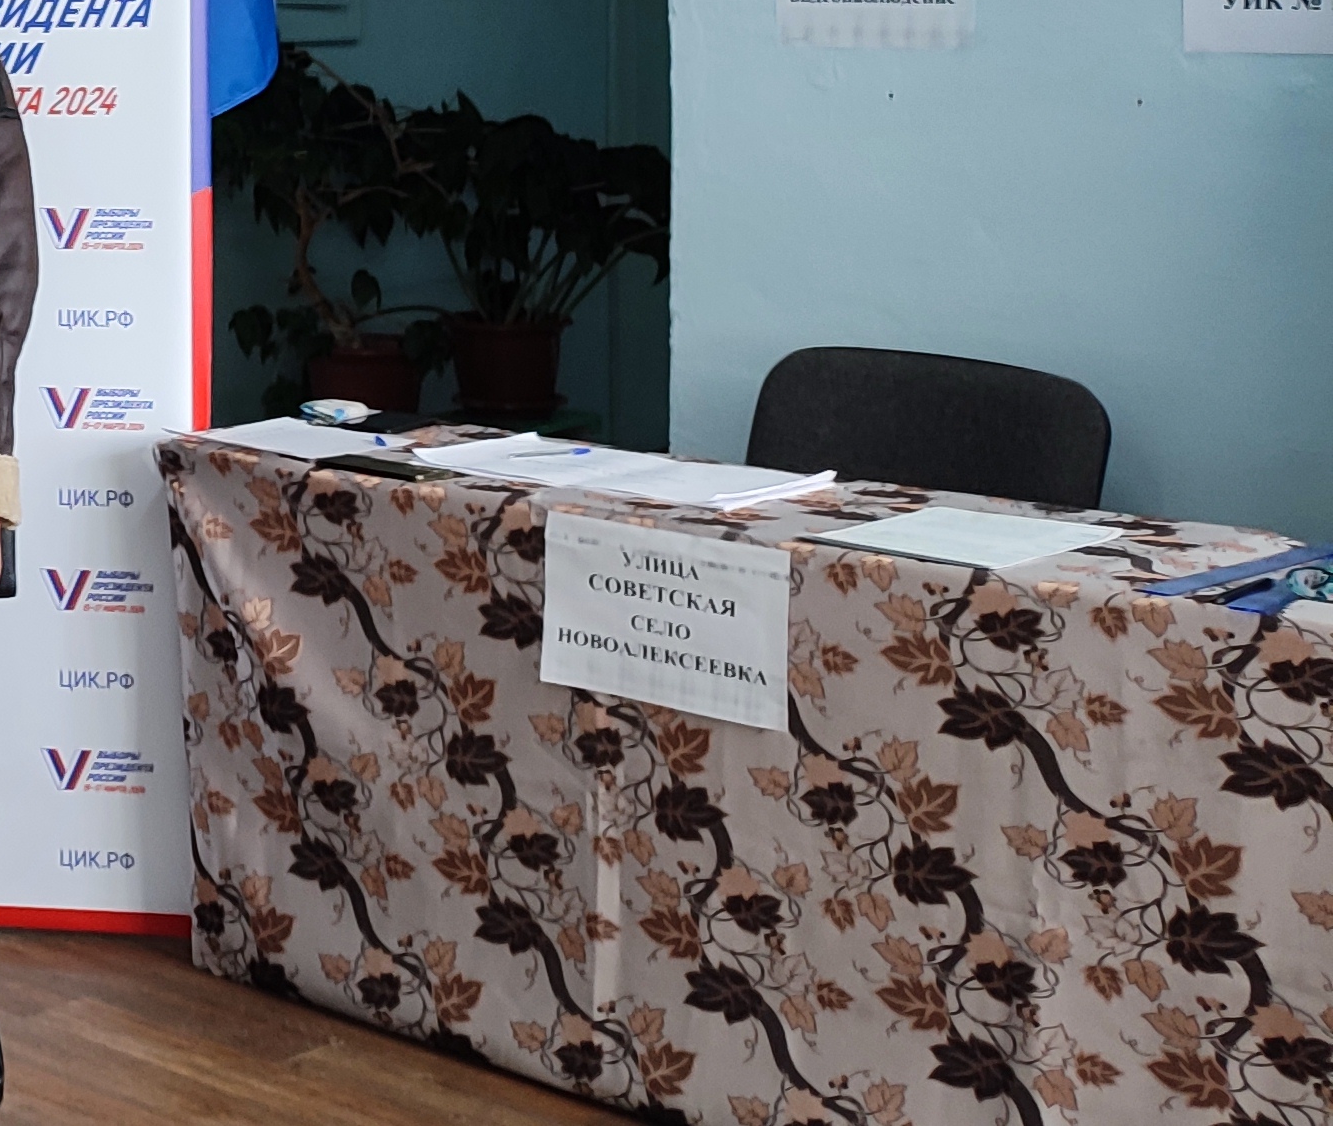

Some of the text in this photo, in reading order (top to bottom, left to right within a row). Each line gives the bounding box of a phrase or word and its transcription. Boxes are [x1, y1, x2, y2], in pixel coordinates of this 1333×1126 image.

[47, 87, 118, 115] 2024
[57, 308, 134, 330] ЦИК.РФ
[58, 488, 134, 510] ЦИК.РФ
[620, 548, 700, 581] УЛИЦА
[588, 573, 737, 618] СОВЕТСКАЯ
[630, 614, 692, 641] СЕЛО
[558, 627, 768, 687] НОВОАЛЕКСЕЕВКА
[59, 669, 135, 691] ЦИК.РФ
[59, 849, 135, 871] ЦИК.РФ
